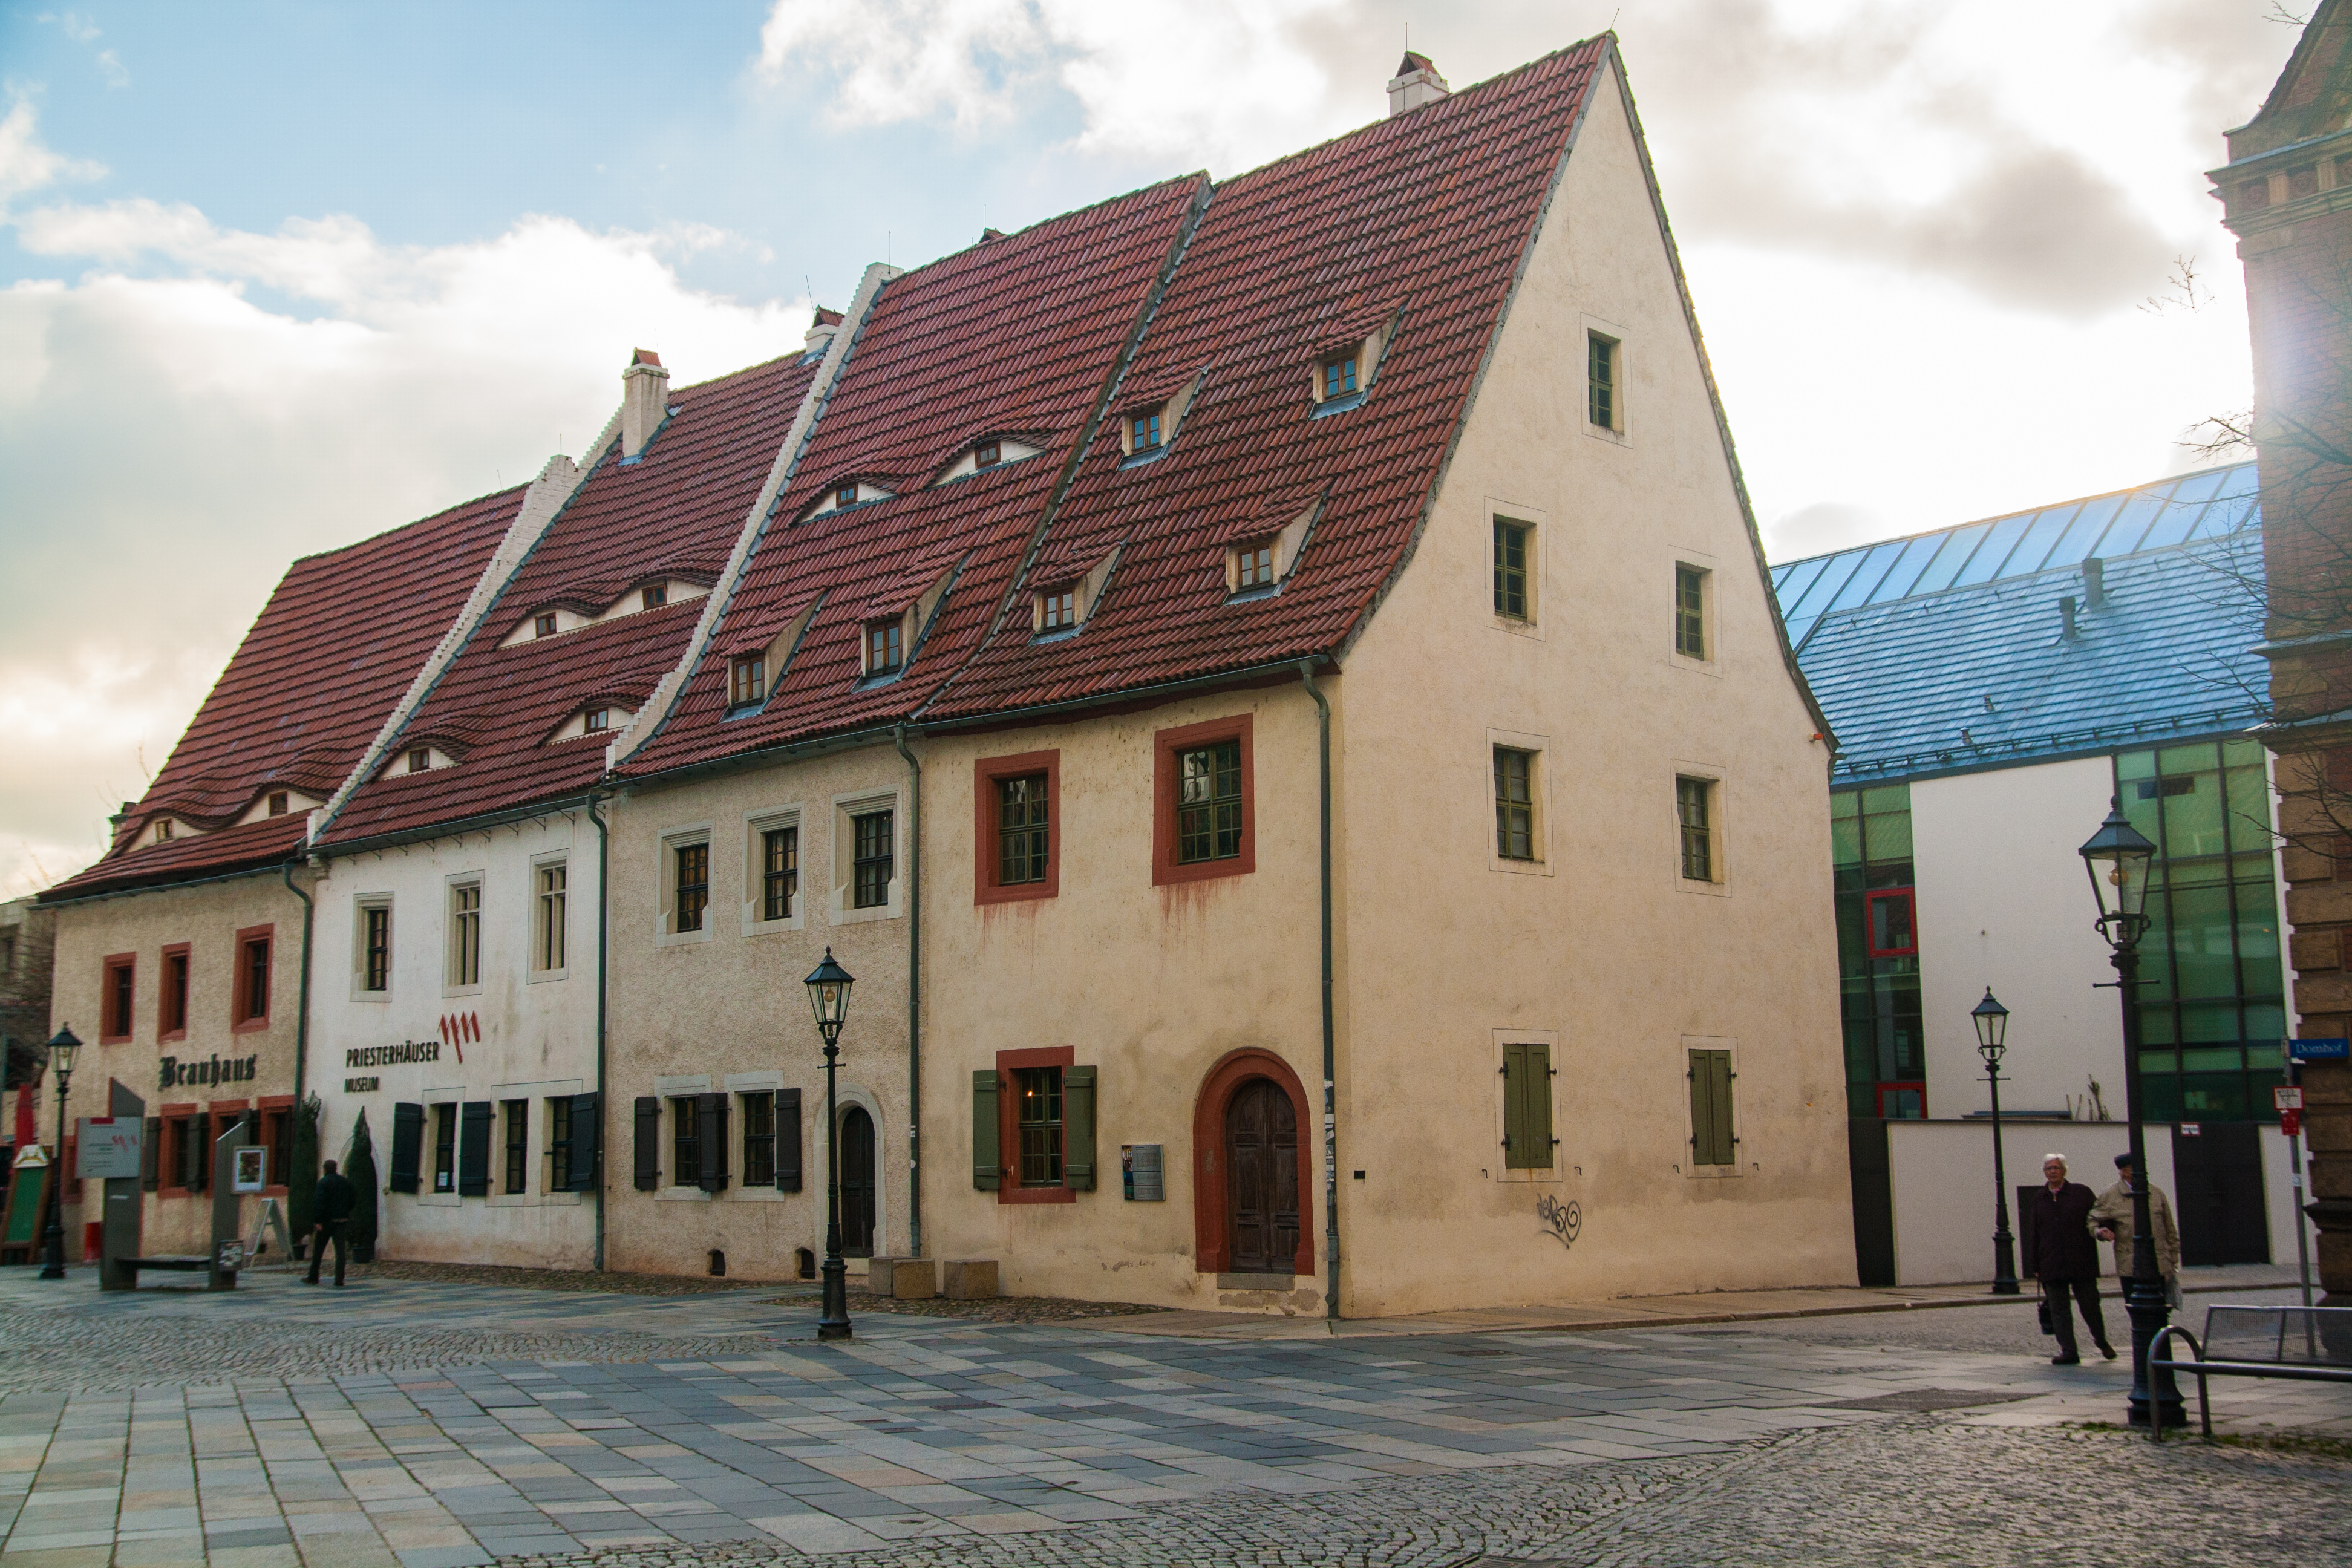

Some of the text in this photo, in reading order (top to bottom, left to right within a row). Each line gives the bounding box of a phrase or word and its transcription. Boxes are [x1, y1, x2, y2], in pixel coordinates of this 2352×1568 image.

[346, 1040, 439, 1068] PRIESTERHÄUSER
[2296, 1043, 2344, 1053] Domhof
[157, 1053, 257, 1092] Brauhaus
[344, 1076, 380, 1093] MUSEUM
